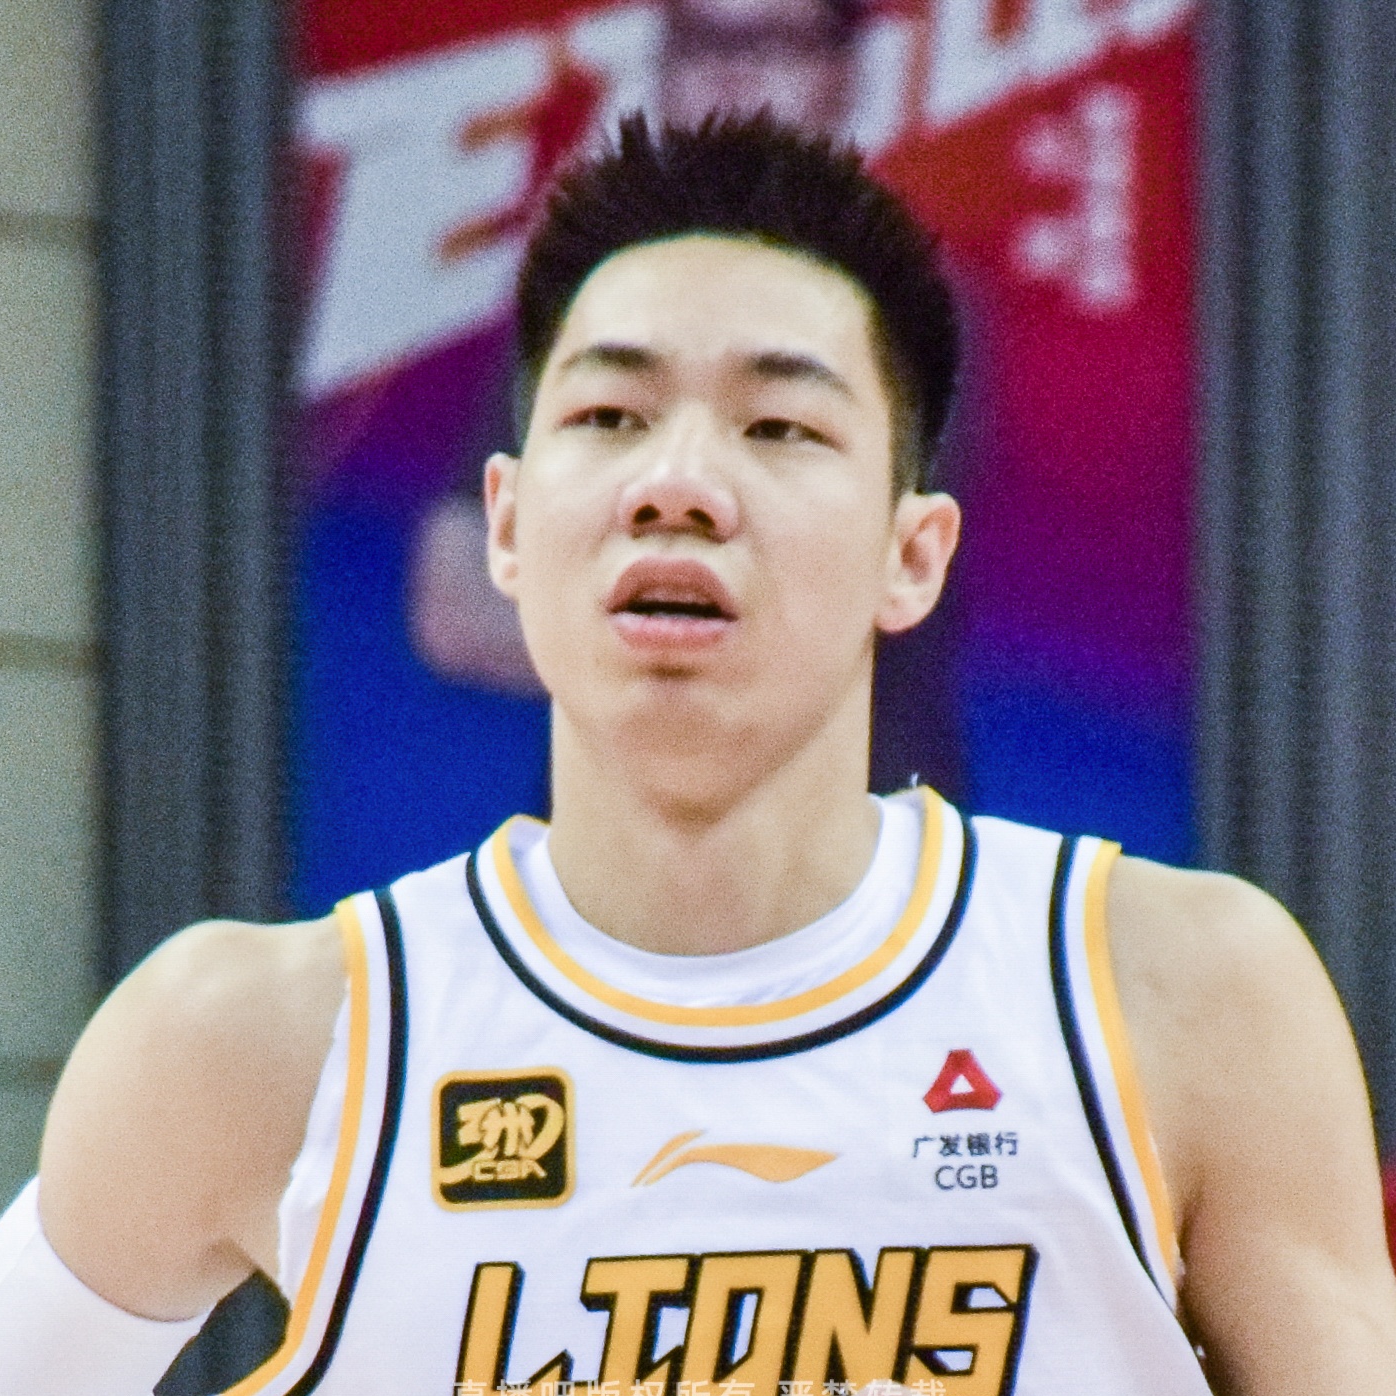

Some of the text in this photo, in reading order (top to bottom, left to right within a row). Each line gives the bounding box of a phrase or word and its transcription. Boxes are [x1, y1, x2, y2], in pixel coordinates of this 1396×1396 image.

[912, 1131, 1019, 1158] 广发银行
[935, 1164, 999, 1190] CGB
